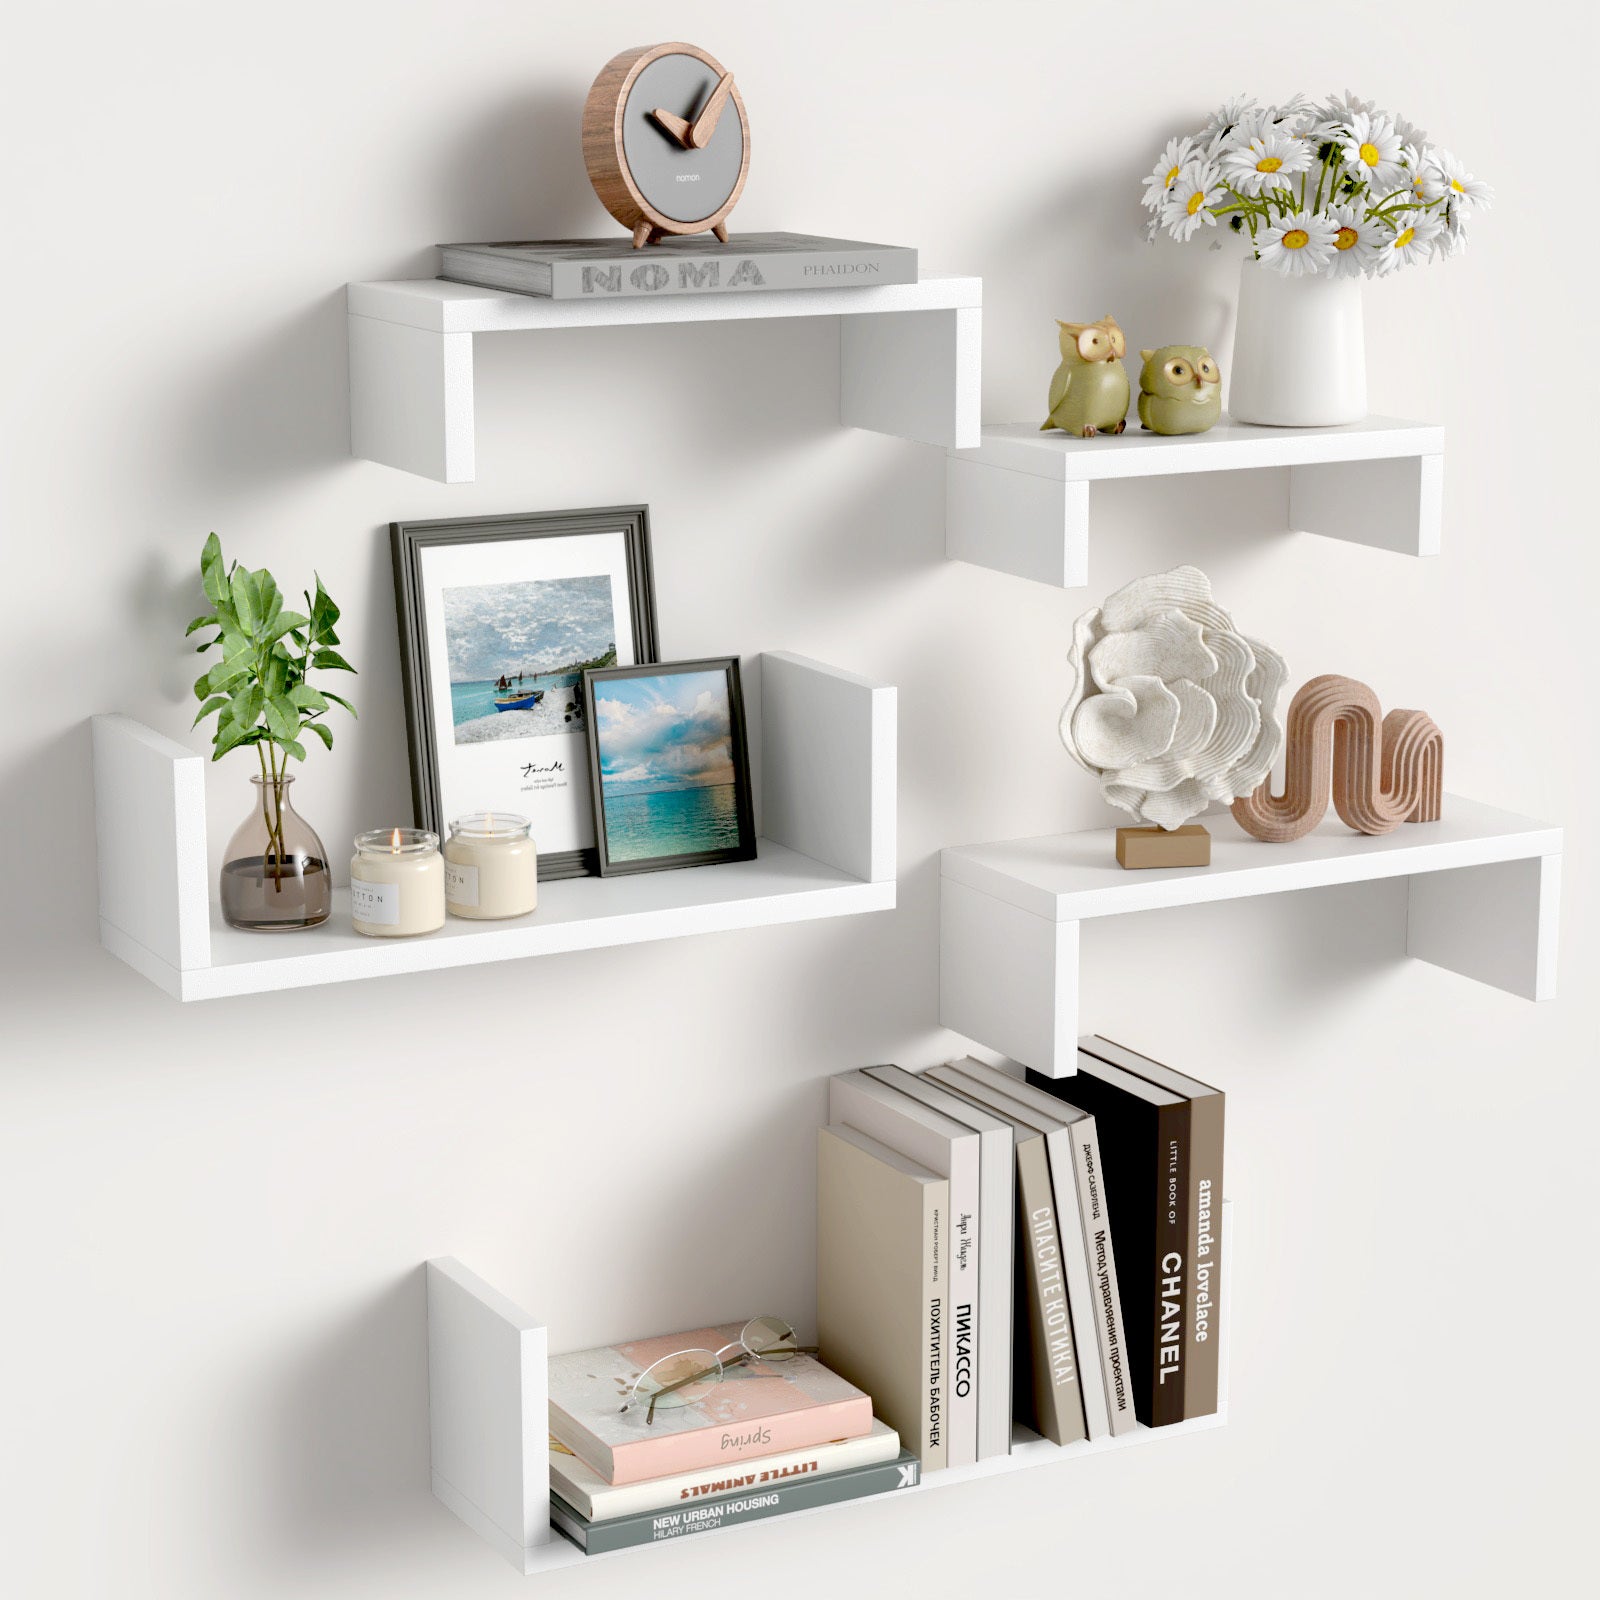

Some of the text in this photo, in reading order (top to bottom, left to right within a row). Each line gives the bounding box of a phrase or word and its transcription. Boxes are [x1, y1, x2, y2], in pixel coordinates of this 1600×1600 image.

[676, 173, 700, 182] nomon
[582, 260, 765, 292] NOMA
[804, 263, 879, 276] PHAIDON
[1083, 1144, 1100, 1220] ДЖЕФФ САЗЕРЛЕНД
[1168, 1212, 1176, 1225] OF
[1195, 1179, 1214, 1343] amanda lovelace
[1032, 1207, 1074, 1386] СПАСИТЕ КОТИКА!
[1093, 1229, 1106, 1272] Метод
[1109, 1346, 1127, 1412] проектами
[1159, 1252, 1182, 1385] CHANEL
[956, 1304, 971, 1398] ПИКАССО
[930, 1298, 941, 1448] ПОХИТИТЕЛЬ БАБОЧЕК
[721, 1427, 771, 1450] Spring
[681, 1461, 817, 1499] LITTLE ANIMALS
[653, 1494, 779, 1530] NEW URBAN HOUSING
[653, 1518, 721, 1541] HILARY FRENCH
